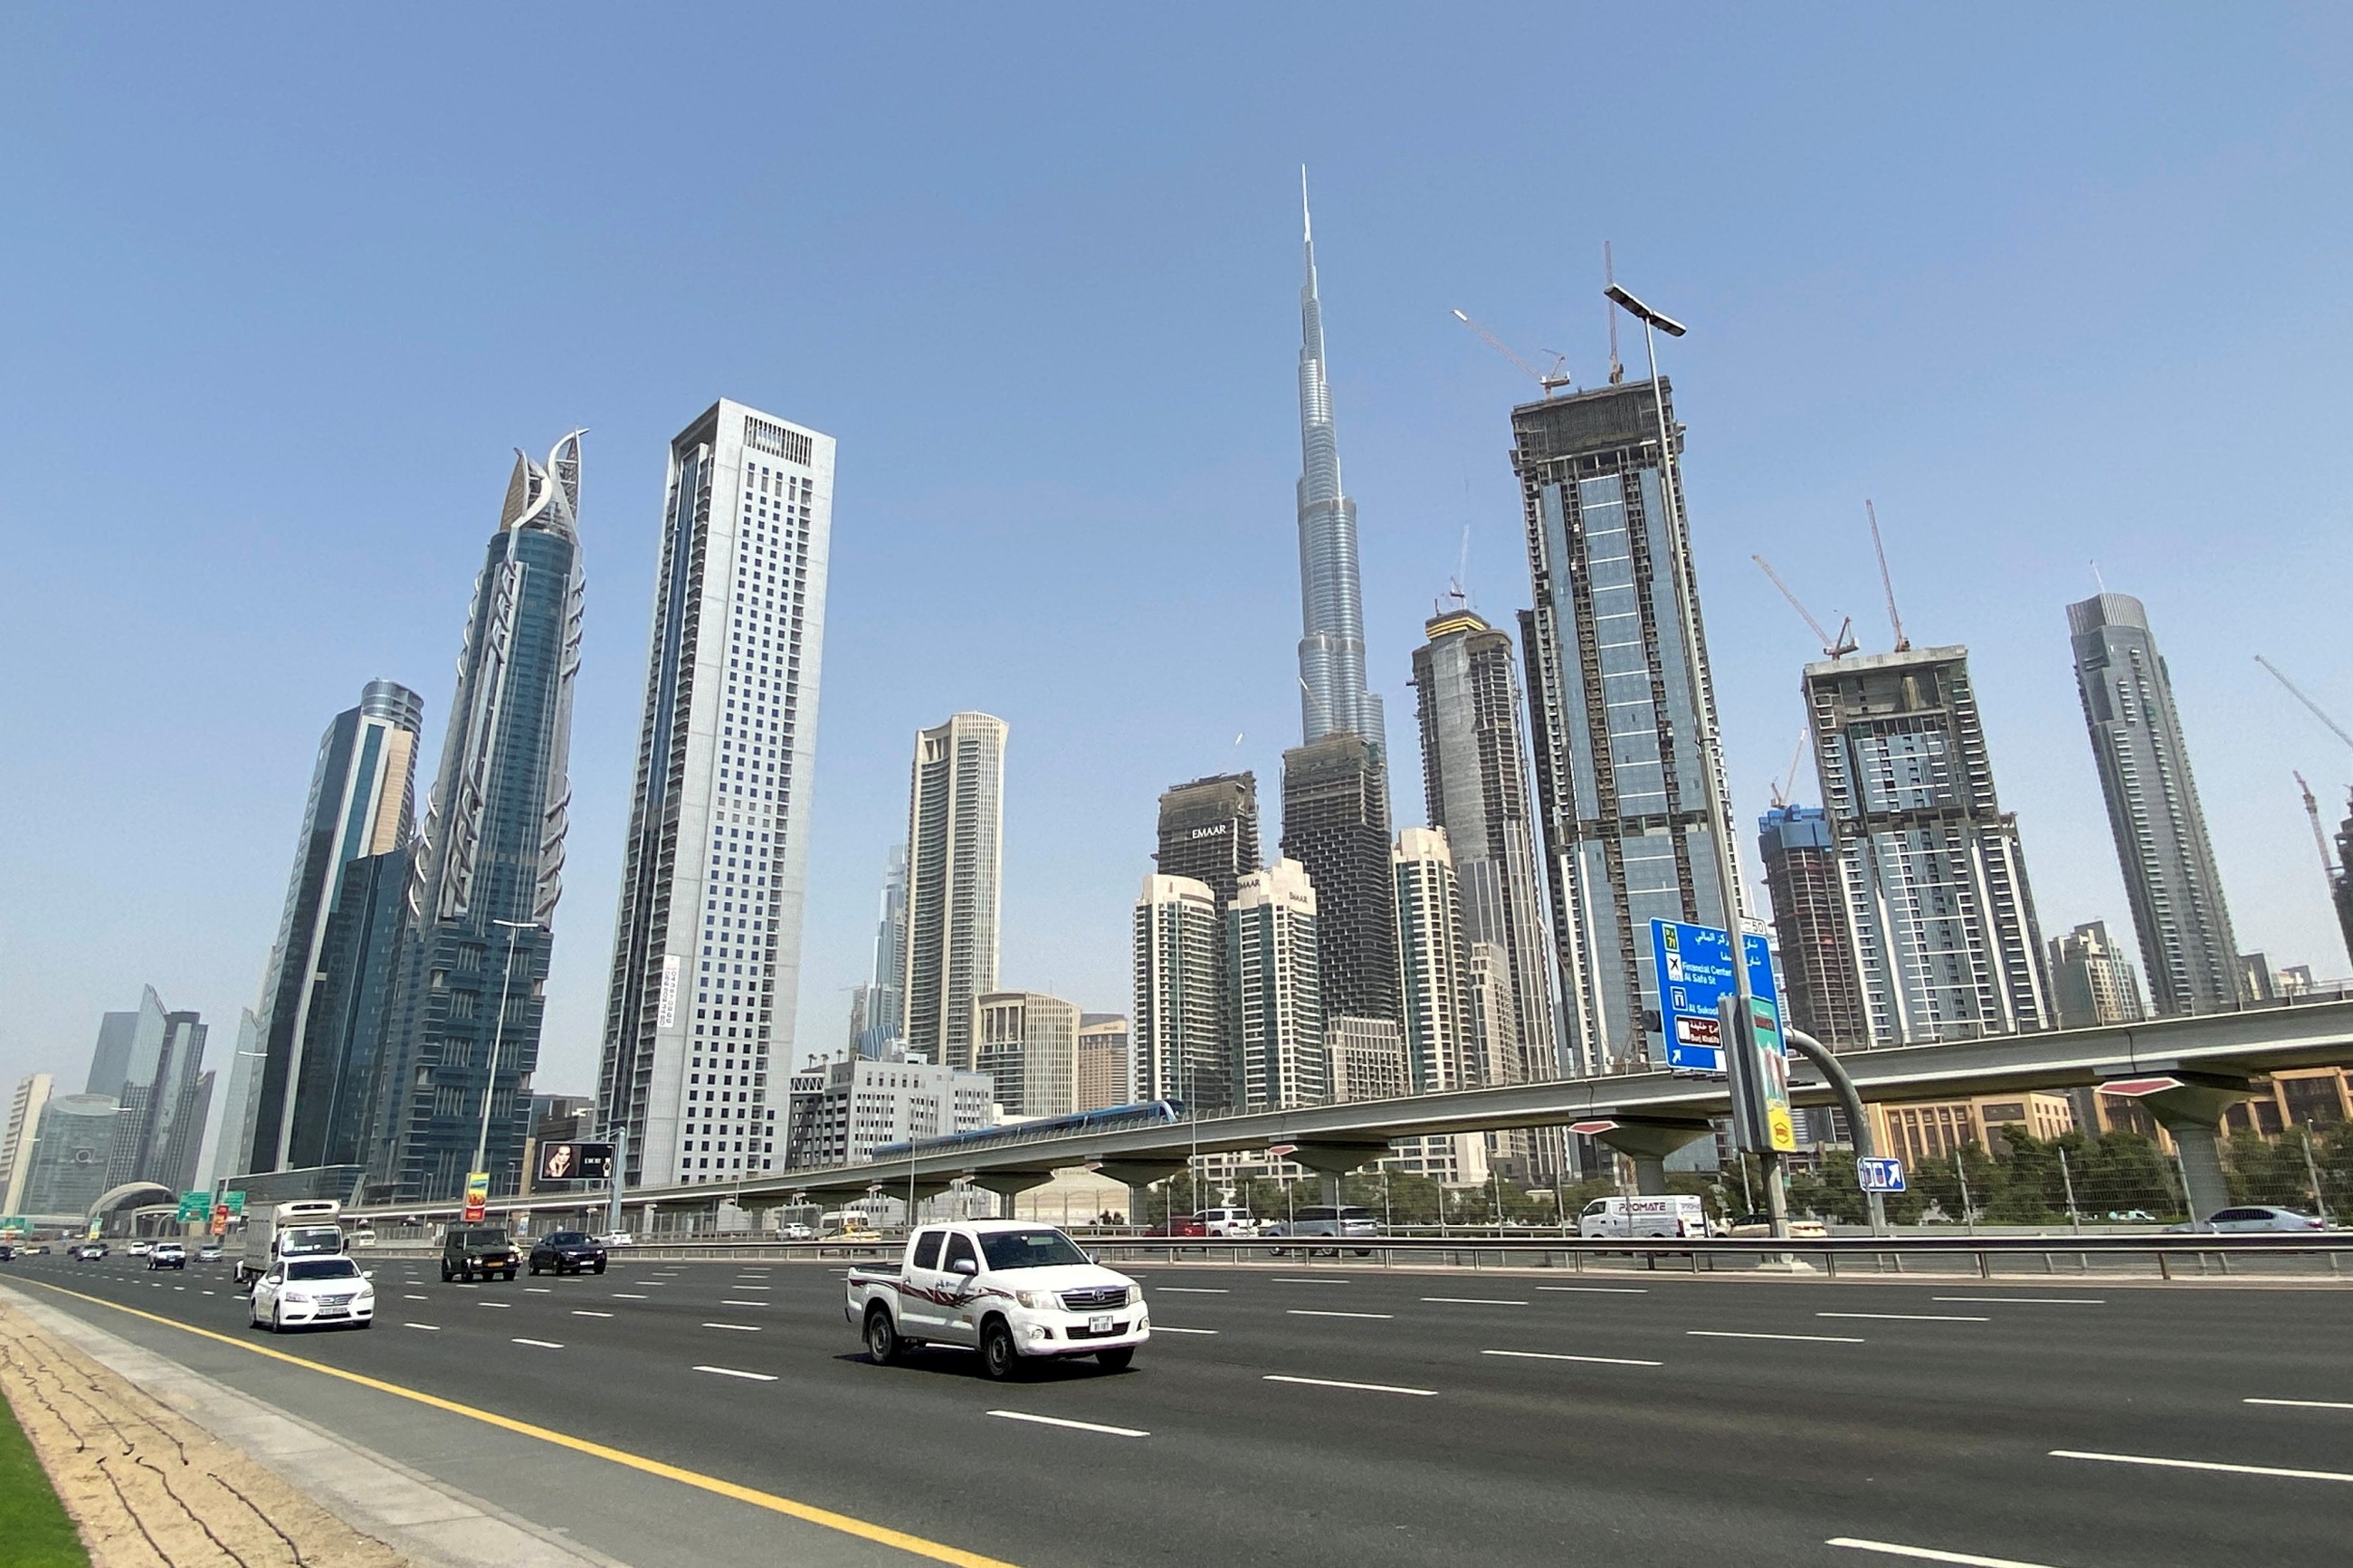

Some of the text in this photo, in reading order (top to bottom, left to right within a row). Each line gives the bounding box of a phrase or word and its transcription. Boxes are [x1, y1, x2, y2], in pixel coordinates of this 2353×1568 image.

[1192, 824, 1226, 839] EMAAR
[1752, 920, 1764, 933] 50
[1682, 961, 1732, 977] Financial Center
[1692, 973, 1708, 984] Safa
